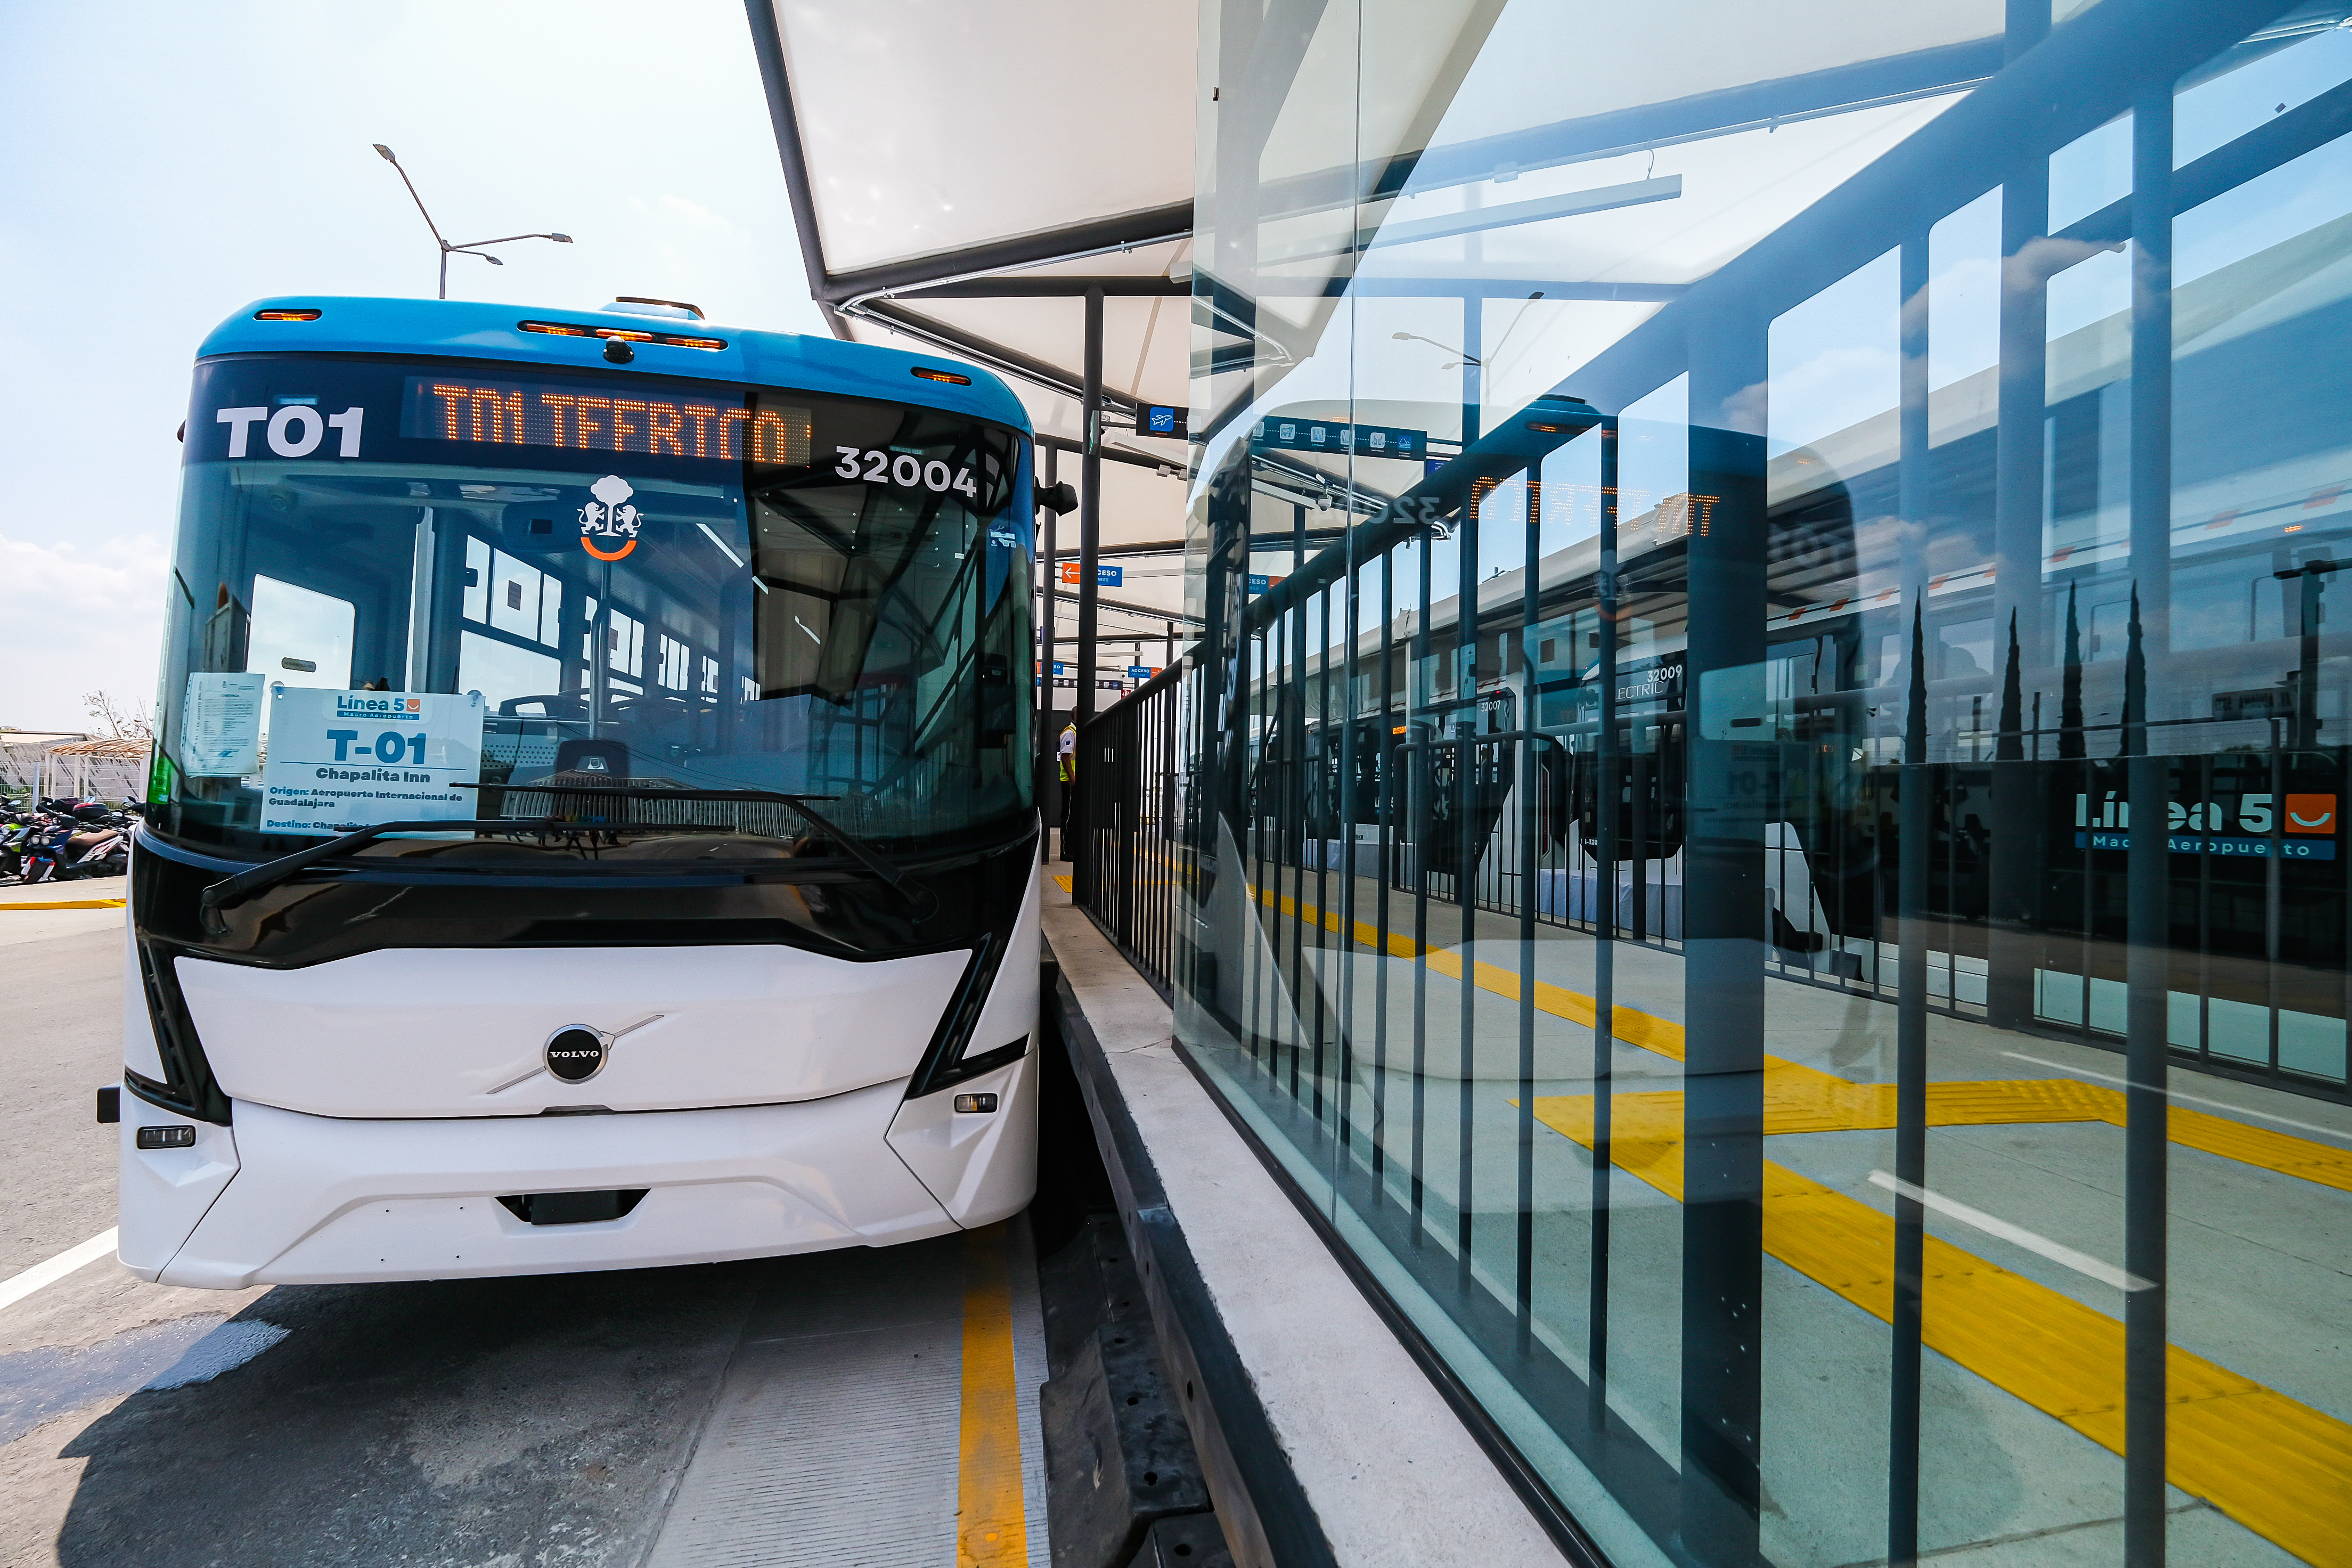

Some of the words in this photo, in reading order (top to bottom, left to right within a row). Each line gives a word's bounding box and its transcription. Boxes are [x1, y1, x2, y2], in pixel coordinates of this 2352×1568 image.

[835, 446, 977, 497] 32004
[1647, 665, 1683, 682] 32009
[1616, 681, 1663, 700] ECTRIC
[337, 695, 389, 711] Línea
[393, 698, 404, 712] 5
[1481, 700, 1501, 712] 32007
[326, 729, 426, 764] T-01
[316, 767, 400, 783] Chapalita
[403, 771, 430, 783] Inn
[270, 786, 309, 797] Origen:
[311, 789, 373, 798] Aeropuerto
[375, 791, 447, 801] Internacional
[449, 793, 463, 802] de
[268, 798, 335, 809] Guadalajara
[2239, 794, 2273, 832] 5
[267, 819, 311, 829] Destino:
[2093, 836, 2129, 847] Mac
[2168, 838, 2310, 855] Aeropueto
